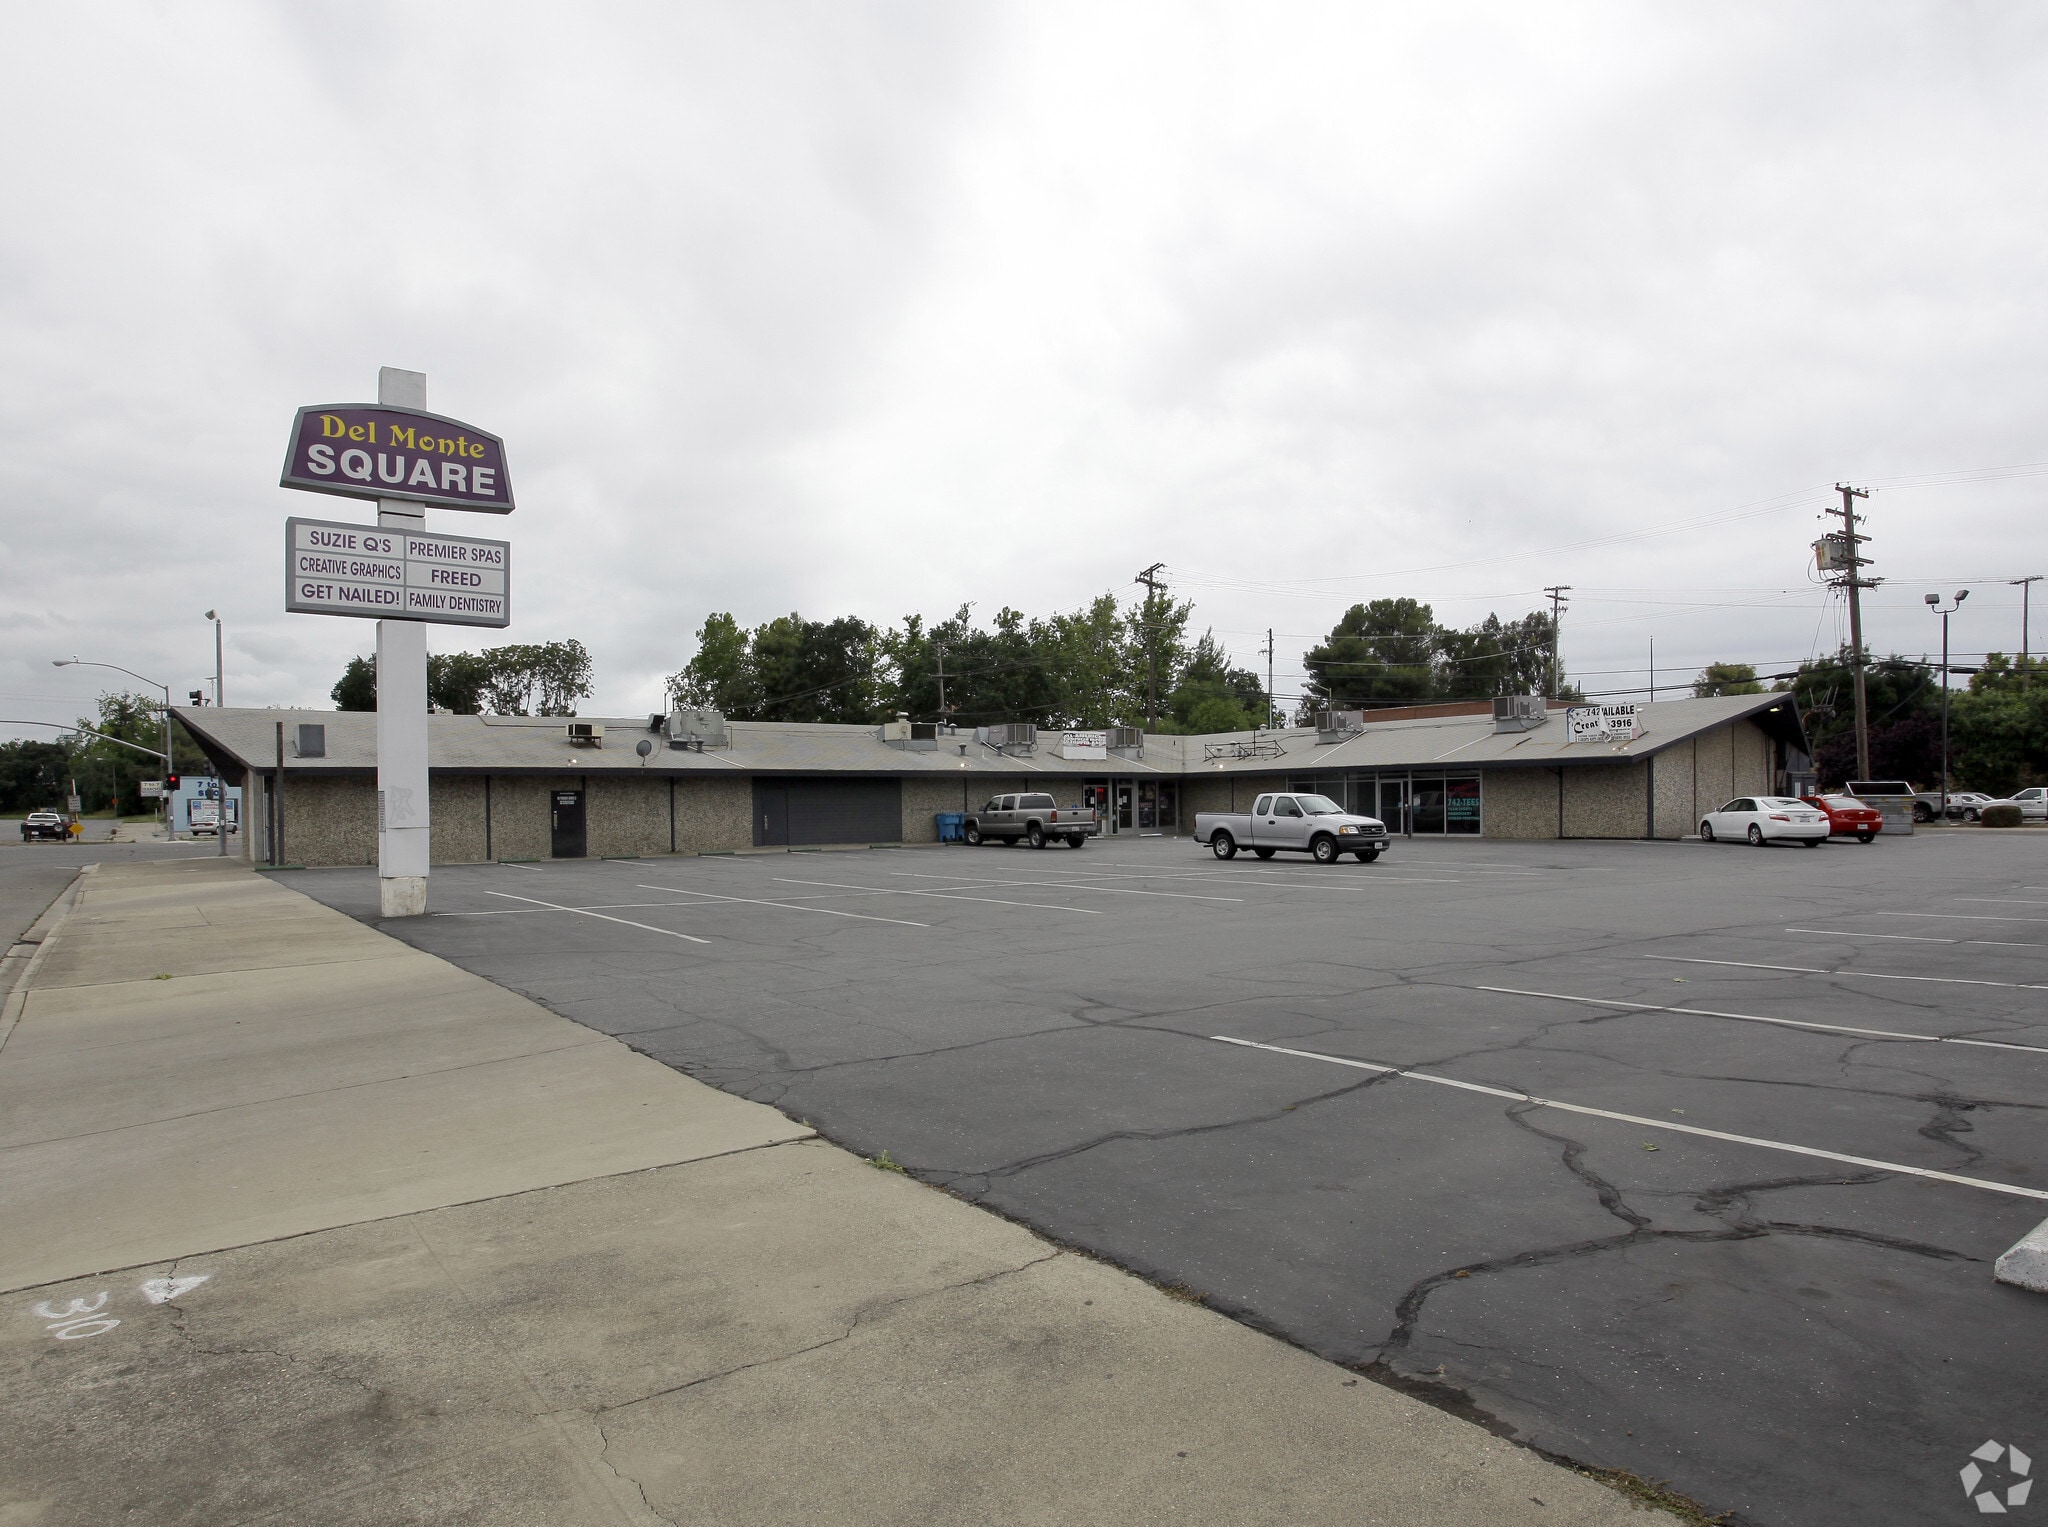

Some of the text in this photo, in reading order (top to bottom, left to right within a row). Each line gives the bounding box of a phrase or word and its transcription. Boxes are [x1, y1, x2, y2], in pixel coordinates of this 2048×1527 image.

[319, 414, 486, 459] Del Monte
[307, 443, 496, 496] SQUARE
[310, 530, 392, 553] SUZIE Q'S
[409, 541, 502, 564] PREMIER SPAS
[300, 556, 401, 580] CREATIVE GRAPHICS
[431, 568, 482, 587] FREED
[301, 583, 400, 606] GET NAILED!
[409, 592, 502, 614] FAMILY DENTISTRY
[1602, 705, 1635, 717] AILABLE
[1573, 719, 1600, 734] Creat
